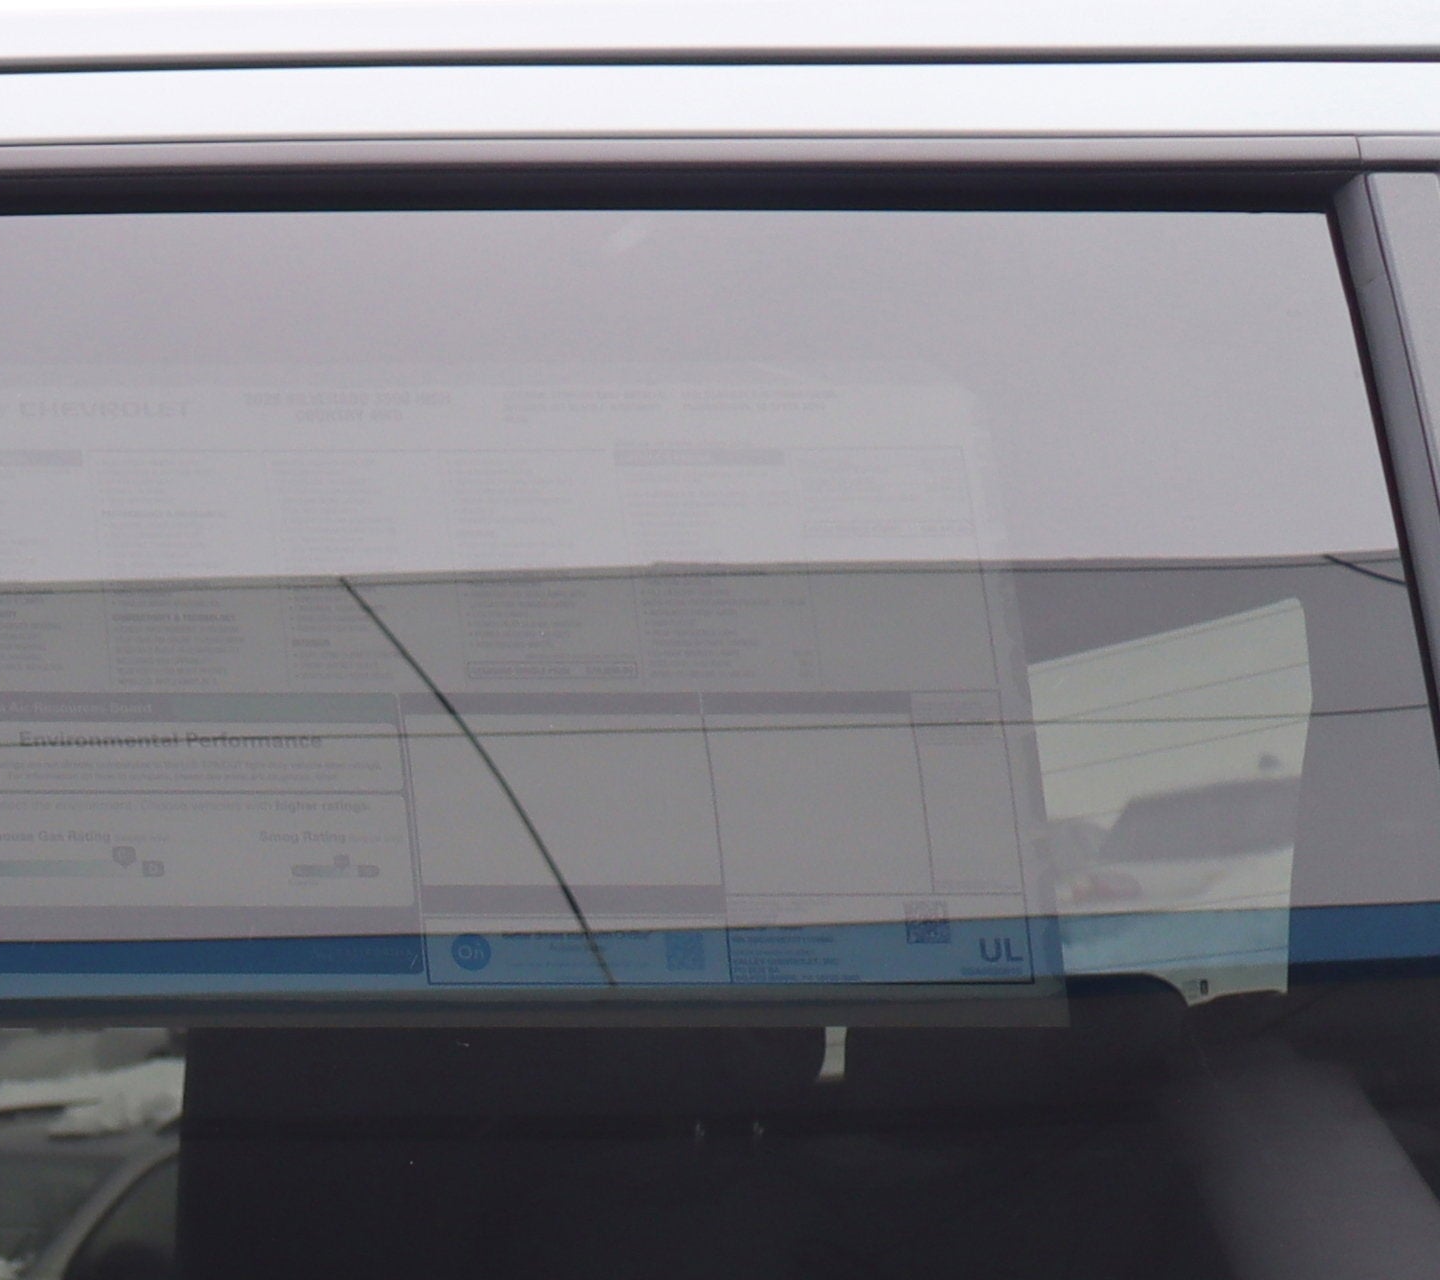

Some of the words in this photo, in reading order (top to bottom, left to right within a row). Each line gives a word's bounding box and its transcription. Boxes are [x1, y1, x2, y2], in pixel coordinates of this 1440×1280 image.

[19, 730, 178, 748] Environmental
[185, 729, 323, 750] Performance
[38, 830, 65, 842] Gas
[67, 830, 112, 844] Rating
[259, 830, 299, 845] Smog
[303, 830, 346, 845] Rating
[979, 937, 1024, 962] UL
